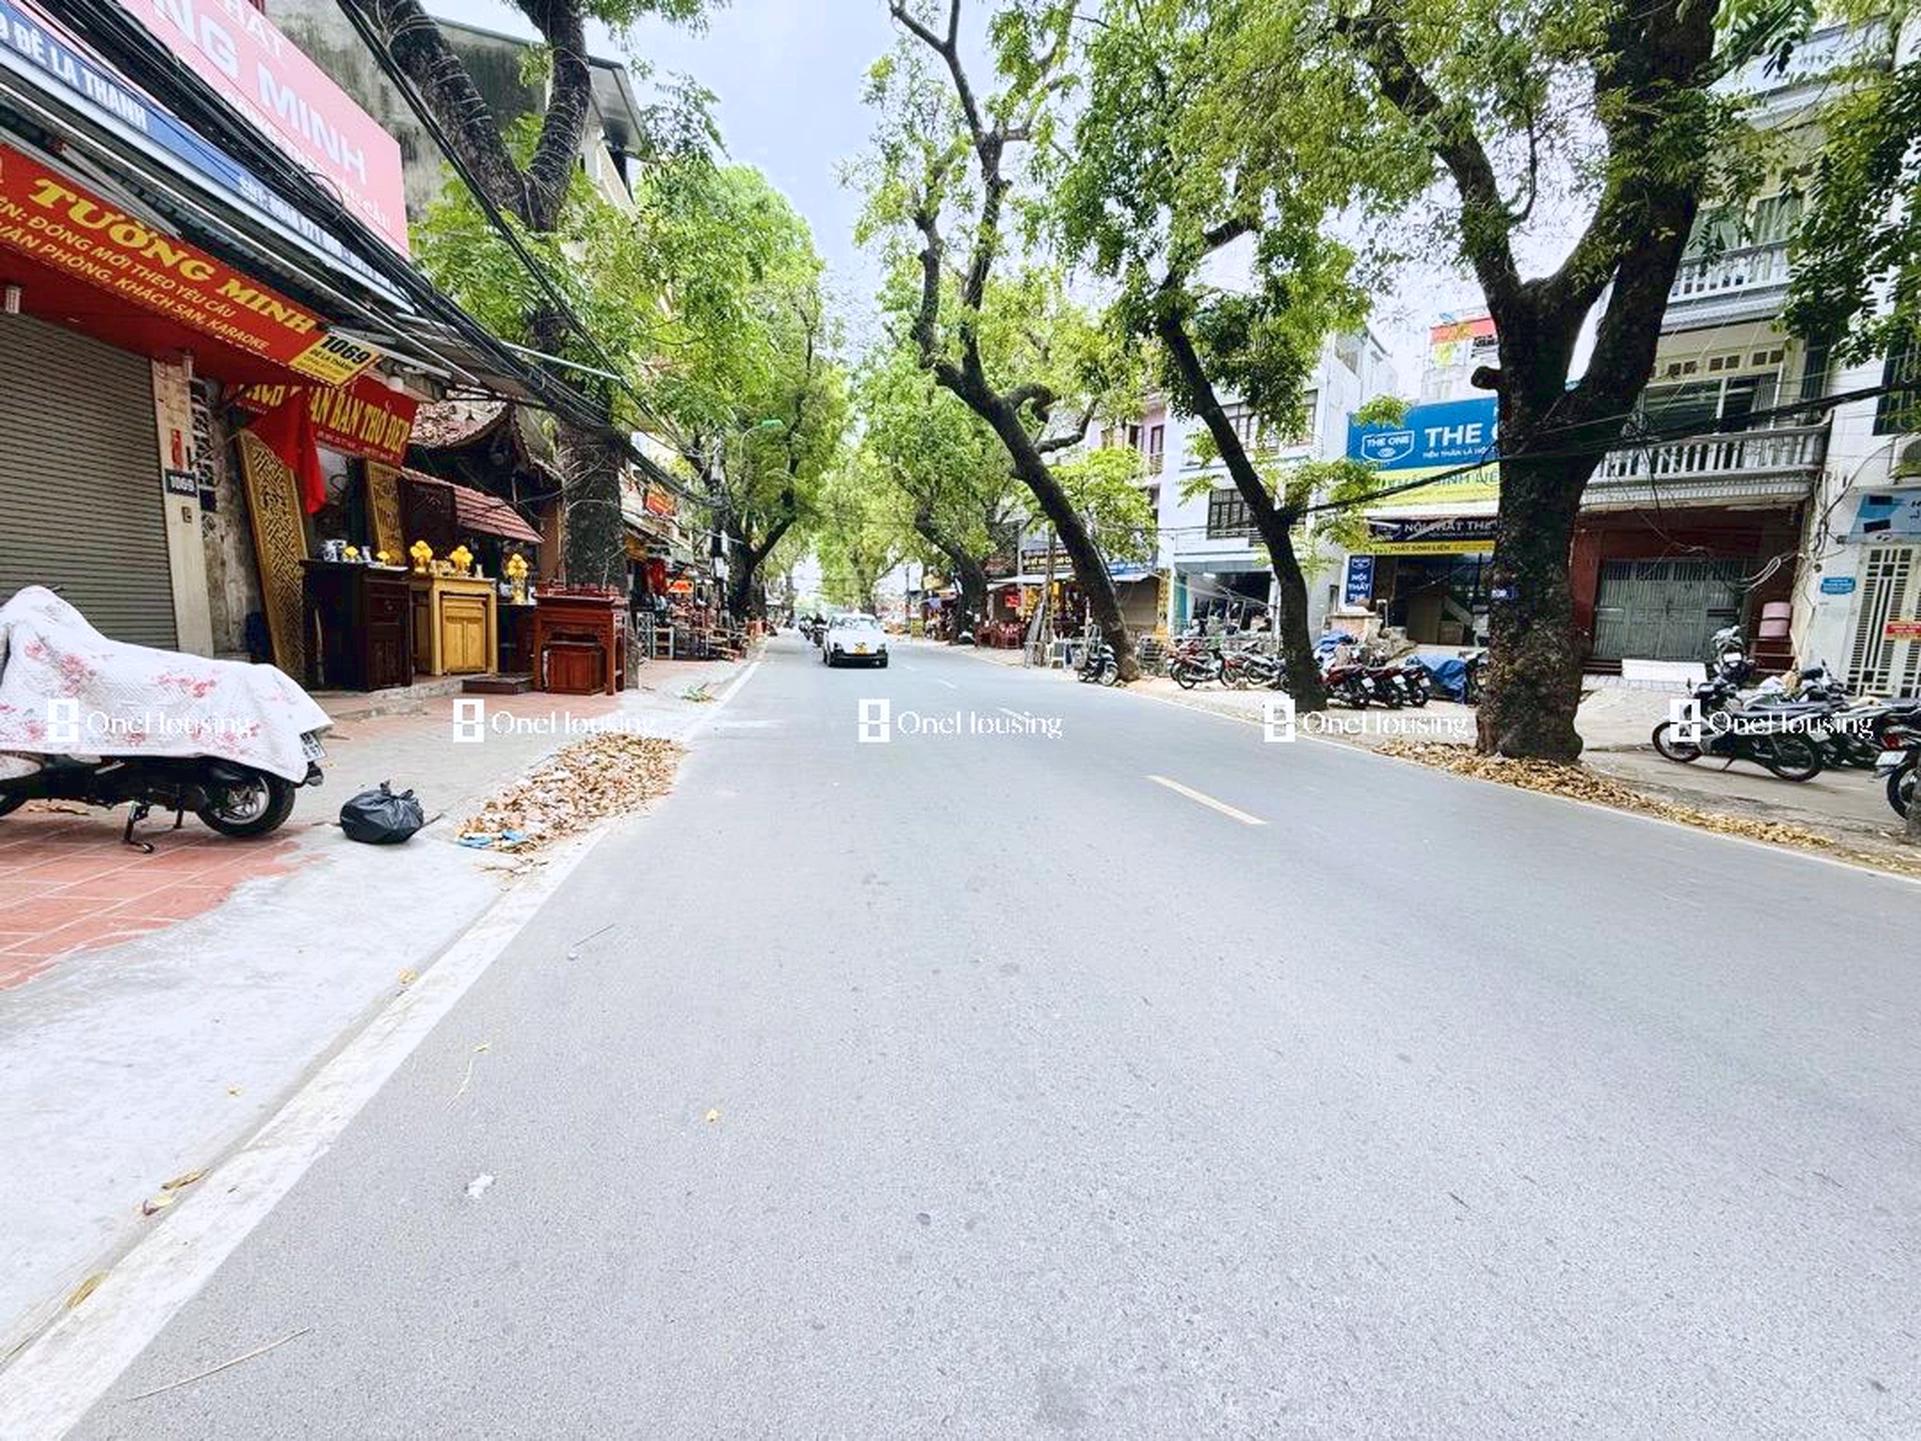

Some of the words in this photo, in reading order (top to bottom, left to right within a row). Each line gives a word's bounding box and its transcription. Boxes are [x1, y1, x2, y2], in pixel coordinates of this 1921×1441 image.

[257, 60, 367, 186] MINH
[28, 178, 216, 281] TƯỜNG
[215, 278, 317, 335] MINH
[91, 246, 132, 269] MỚI
[131, 264, 176, 289] THEO
[175, 284, 207, 304] YÊU
[115, 277, 176, 309] KHÁCH
[206, 319, 270, 350] KARAOKE
[320, 335, 371, 364] 1069
[1366, 437, 1386, 447] THE
[1388, 435, 1410, 445] ONE
[1424, 422, 1483, 448] THE
